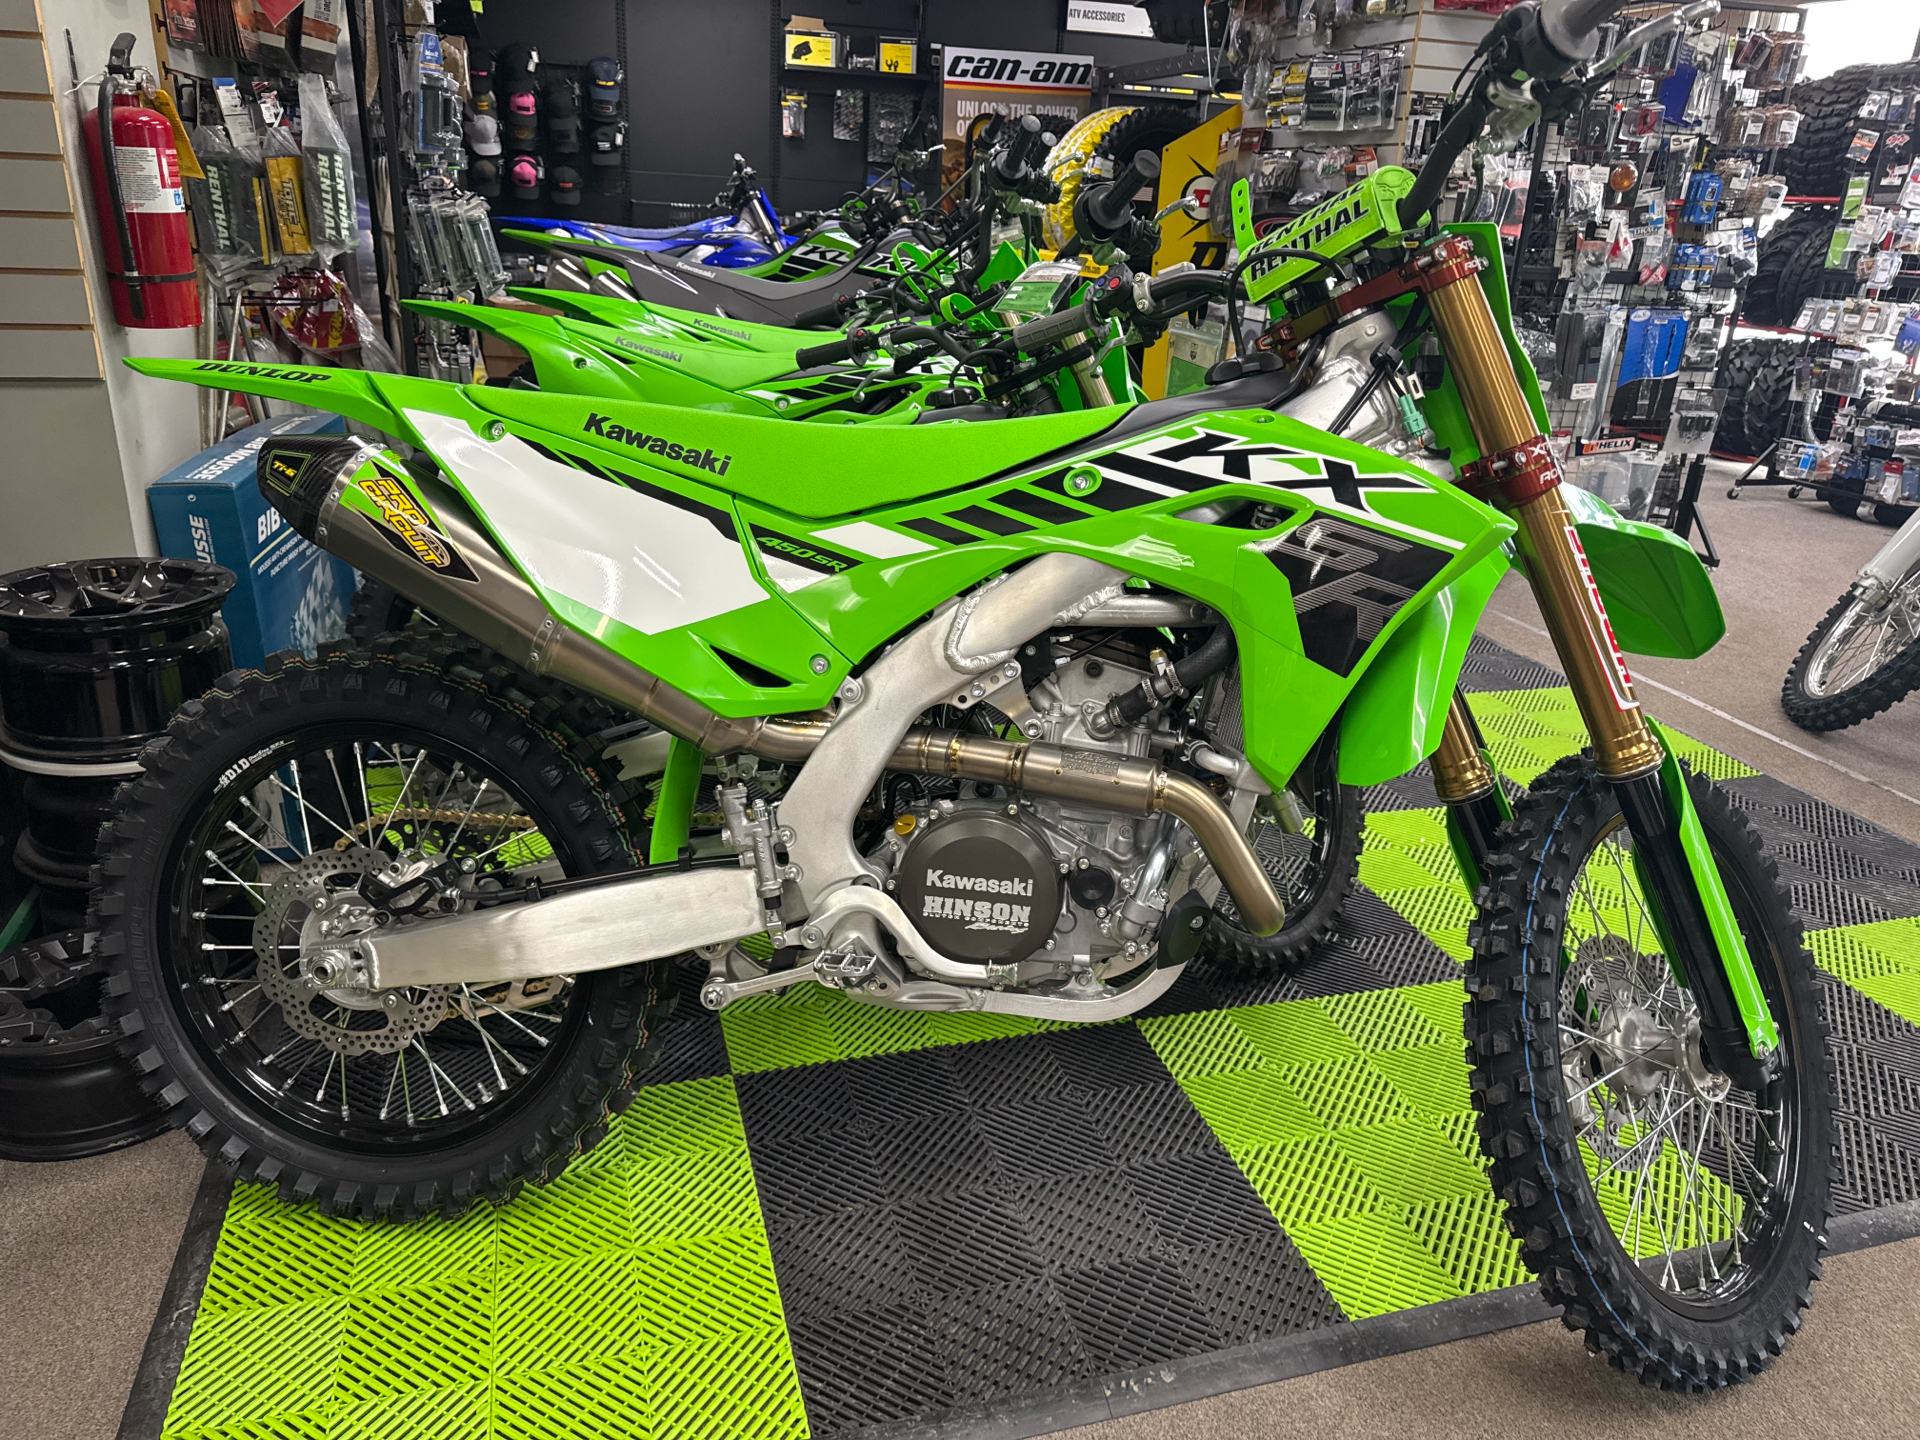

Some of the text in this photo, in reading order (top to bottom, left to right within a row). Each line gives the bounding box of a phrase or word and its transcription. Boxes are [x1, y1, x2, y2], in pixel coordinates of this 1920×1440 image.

[1068, 8, 1126, 23] ATV ACCESSORIES
[947, 55, 1092, 85] can-am
[956, 100, 1005, 118] UNLOC
[1009, 103, 1033, 119] THE
[206, 164, 230, 249] RENTHAL
[317, 153, 337, 240] RENTHAL
[333, 154, 350, 240] RENTHAL
[1247, 183, 1365, 257] RENTHAL
[1250, 198, 1370, 284] RENTHAL
[676, 261, 717, 279] Kawasaki
[693, 317, 752, 342] Kawasaki
[614, 334, 683, 363] Kawasaki
[191, 362, 332, 383] DUNLOP
[582, 412, 732, 477] Kawasaki
[1598, 438, 1633, 449] HELIX
[193, 448, 256, 480] MOUSSE
[1147, 431, 1430, 513] KX
[376, 478, 429, 526] PRO
[257, 506, 281, 545] BIB
[358, 480, 444, 566] CIRCUIT
[756, 537, 848, 573] 450SR
[926, 868, 1034, 897] Kawasaki
[923, 895, 1032, 923] HINSON
